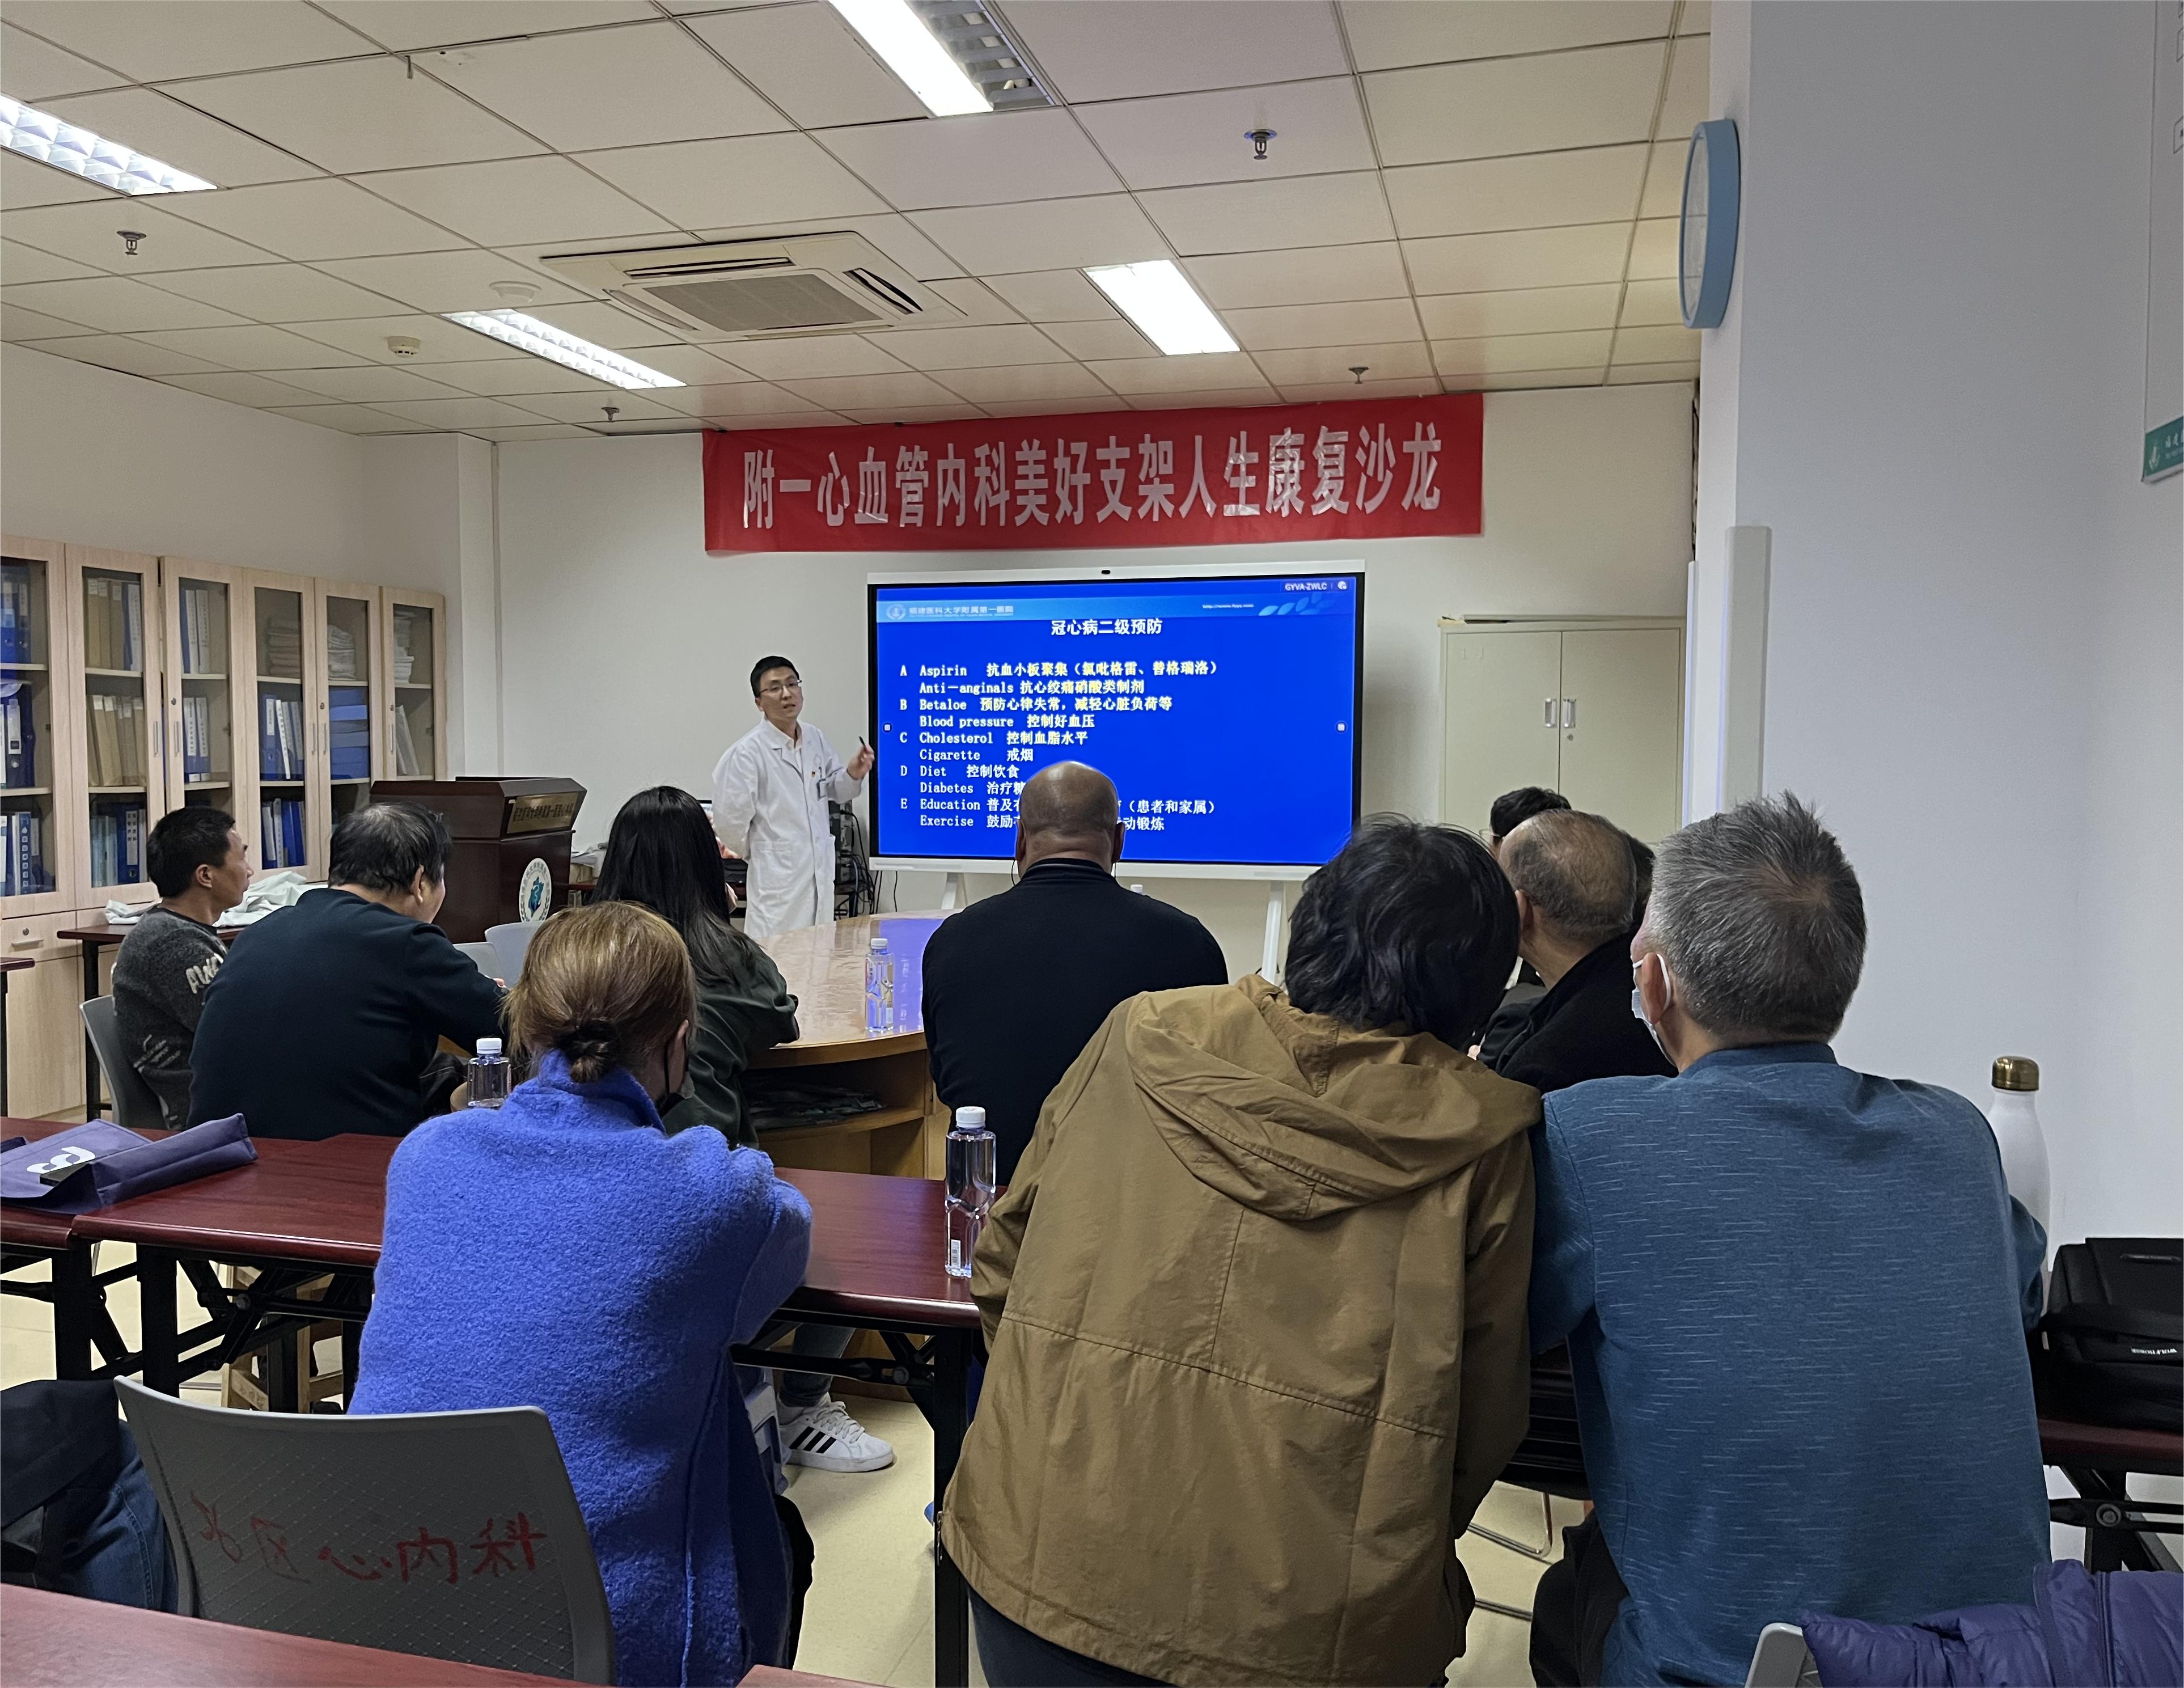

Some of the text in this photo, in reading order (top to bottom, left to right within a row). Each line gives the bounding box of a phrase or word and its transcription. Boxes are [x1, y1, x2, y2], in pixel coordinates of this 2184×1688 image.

[744, 421, 1441, 530] 附一心血管内科美好支架人生康复沙龙
[1285, 582, 1327, 591] GYVA-ZWLC
[1051, 618, 1163, 636] 冠心病二级预防
[900, 665, 907, 676] A
[920, 665, 967, 678] Aspirin
[1020, 679, 1144, 694] 抗心绞痛硝酸类制剂
[900, 696, 1171, 711] B Betaloe 预防心律失常，减轻心脏负荷等
[920, 714, 1095, 728] Blood pressure 控制好血压
[900, 731, 1087, 744] C Cholesterol 控制血脂水平
[920, 748, 1033, 761] Cigarette 戒烟
[901, 764, 1019, 778] D Diet 控制饮食
[921, 782, 973, 793] Diabetes
[901, 798, 907, 809] E
[921, 799, 980, 810] Education
[921, 815, 973, 826] Exercise
